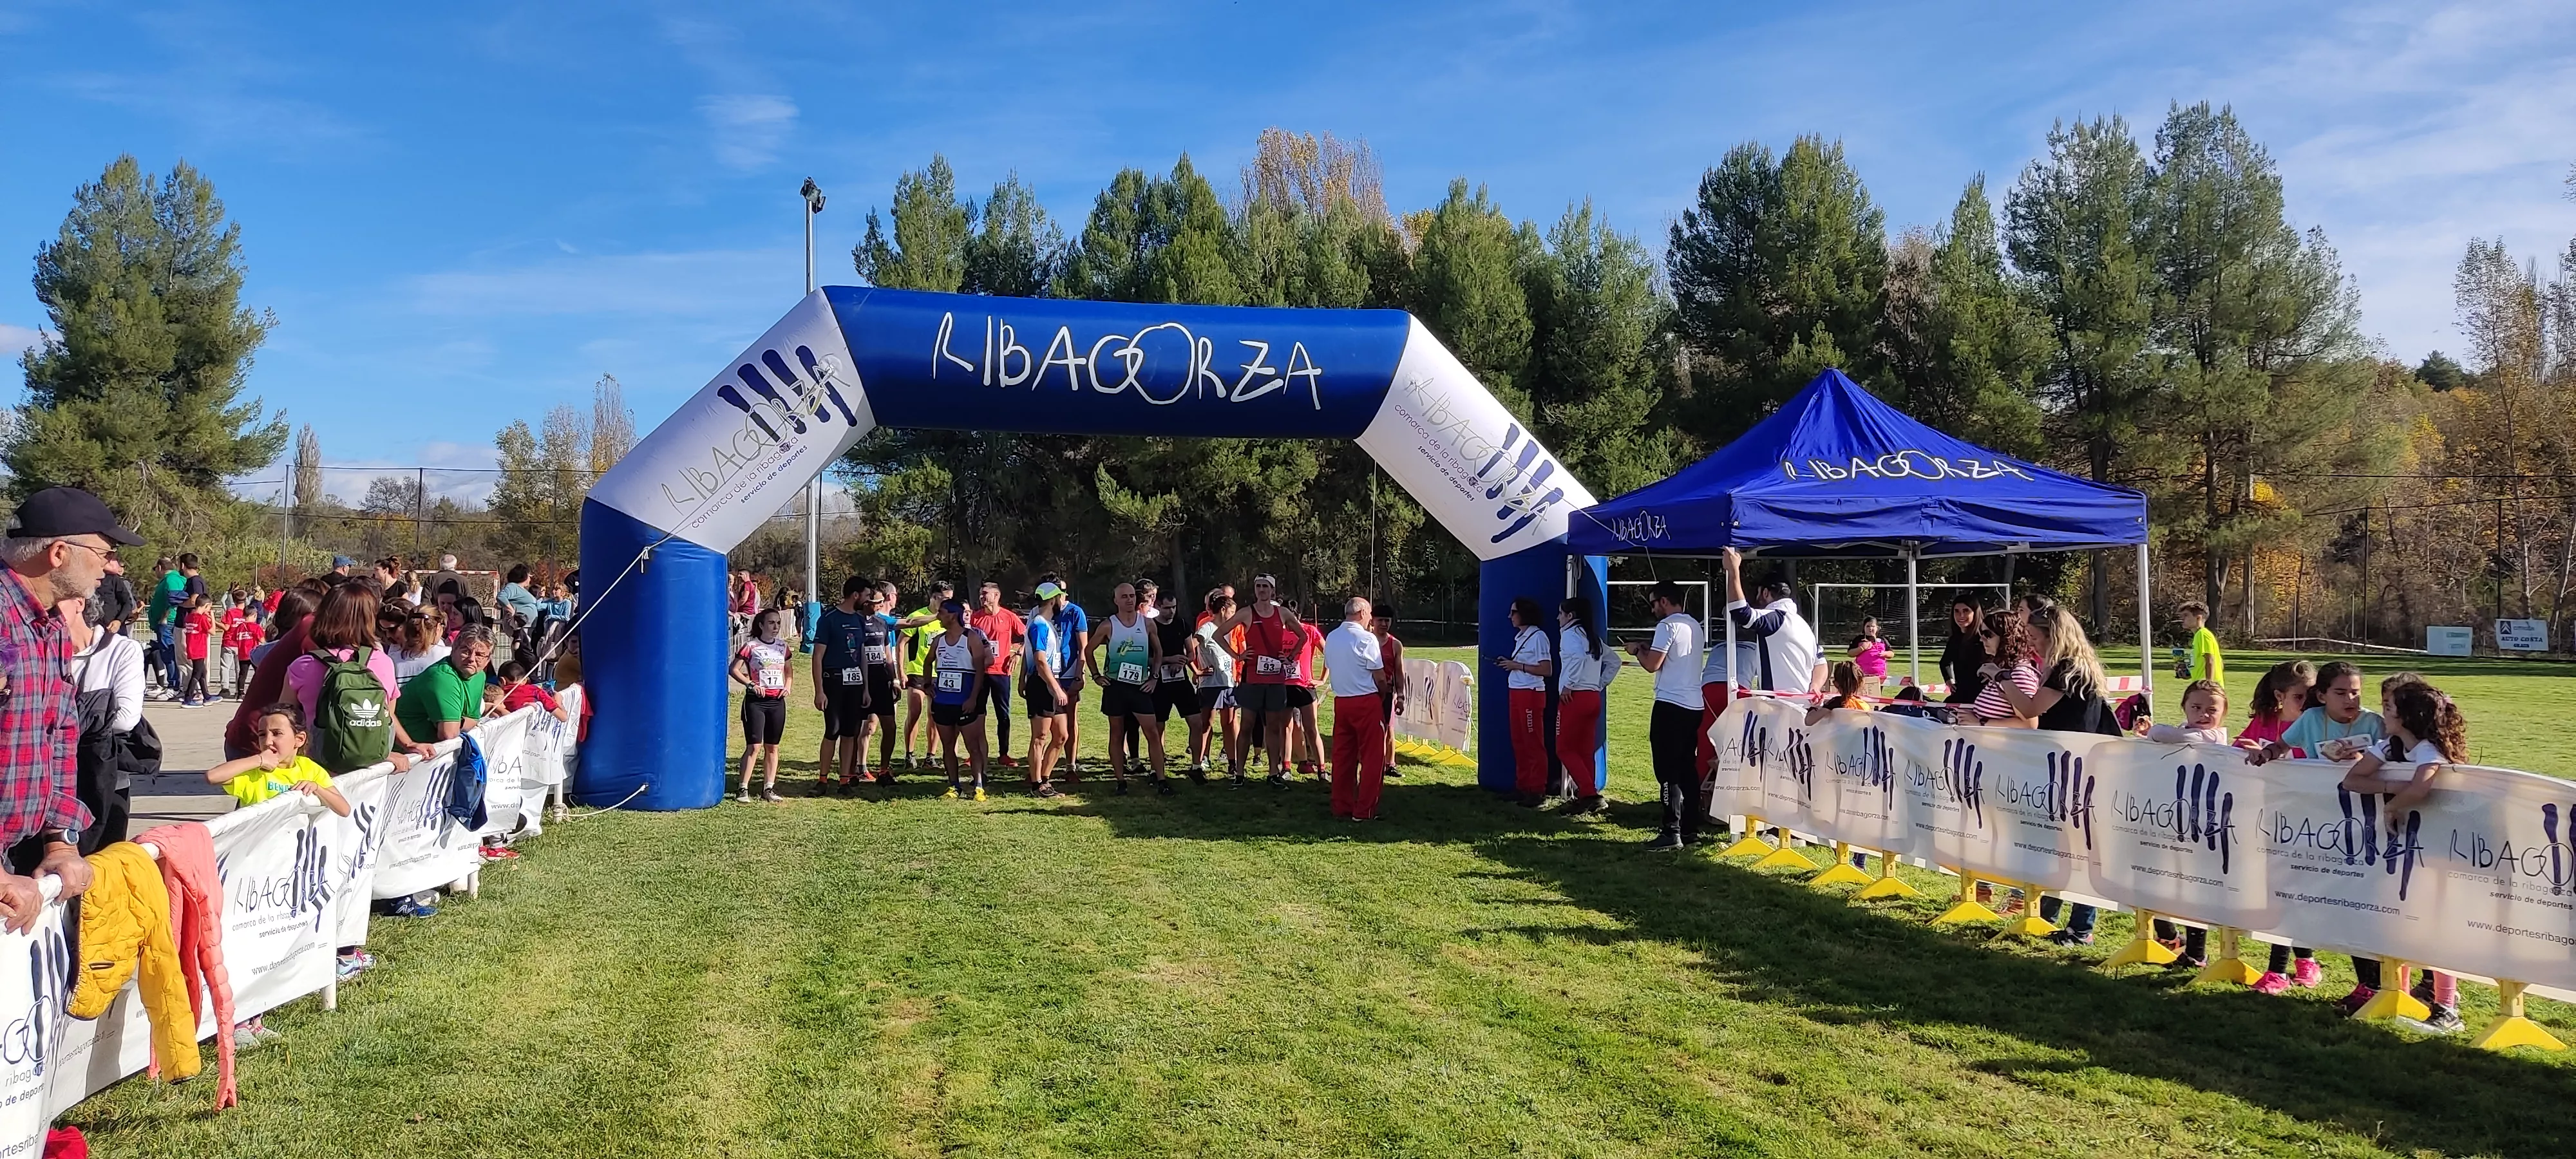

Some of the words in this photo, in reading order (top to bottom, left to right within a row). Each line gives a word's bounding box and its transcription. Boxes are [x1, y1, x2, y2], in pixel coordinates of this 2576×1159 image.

[933, 312, 1322, 411] RIBAGORZA
[1394, 404, 1430, 439] comarca
[1429, 438, 1441, 451] de
[1439, 448, 1449, 459] la
[741, 480, 767, 504] servicio
[767, 471, 777, 481] de
[778, 445, 808, 472] deportes
[1417, 446, 1441, 468] servicio
[1441, 467, 1449, 476] de
[1449, 475, 1475, 502] deportes
[1784, 450, 2035, 481] RIBAGORZA
[692, 492, 734, 529] comarca
[734, 481, 747, 493] de
[745, 473, 757, 482] la
[866, 652, 881, 661] 184
[1123, 670, 1139, 681] 179
[1264, 663, 1275, 672] 93
[767, 677, 778, 685] 17
[847, 673, 860, 681] 185
[943, 679, 954, 688] 43
[2111, 789, 2238, 845] RIBAGORZA
[2139, 827, 2148, 836] de
[2256, 808, 2425, 868] RIBAGORZA
[2257, 847, 2289, 857] comarca
[2292, 849, 2303, 859] de
[2306, 850, 2315, 860] la
[2291, 863, 2318, 873] servicio
[2333, 869, 2364, 878] deportes
[2448, 871, 2488, 883] comarca
[2493, 876, 2505, 886] de
[2509, 878, 2517, 888] la
[2275, 890, 2400, 916] www.deportesribagorza.com
[2490, 890, 2522, 901] servicio
[2537, 898, 2573, 910] deportes
